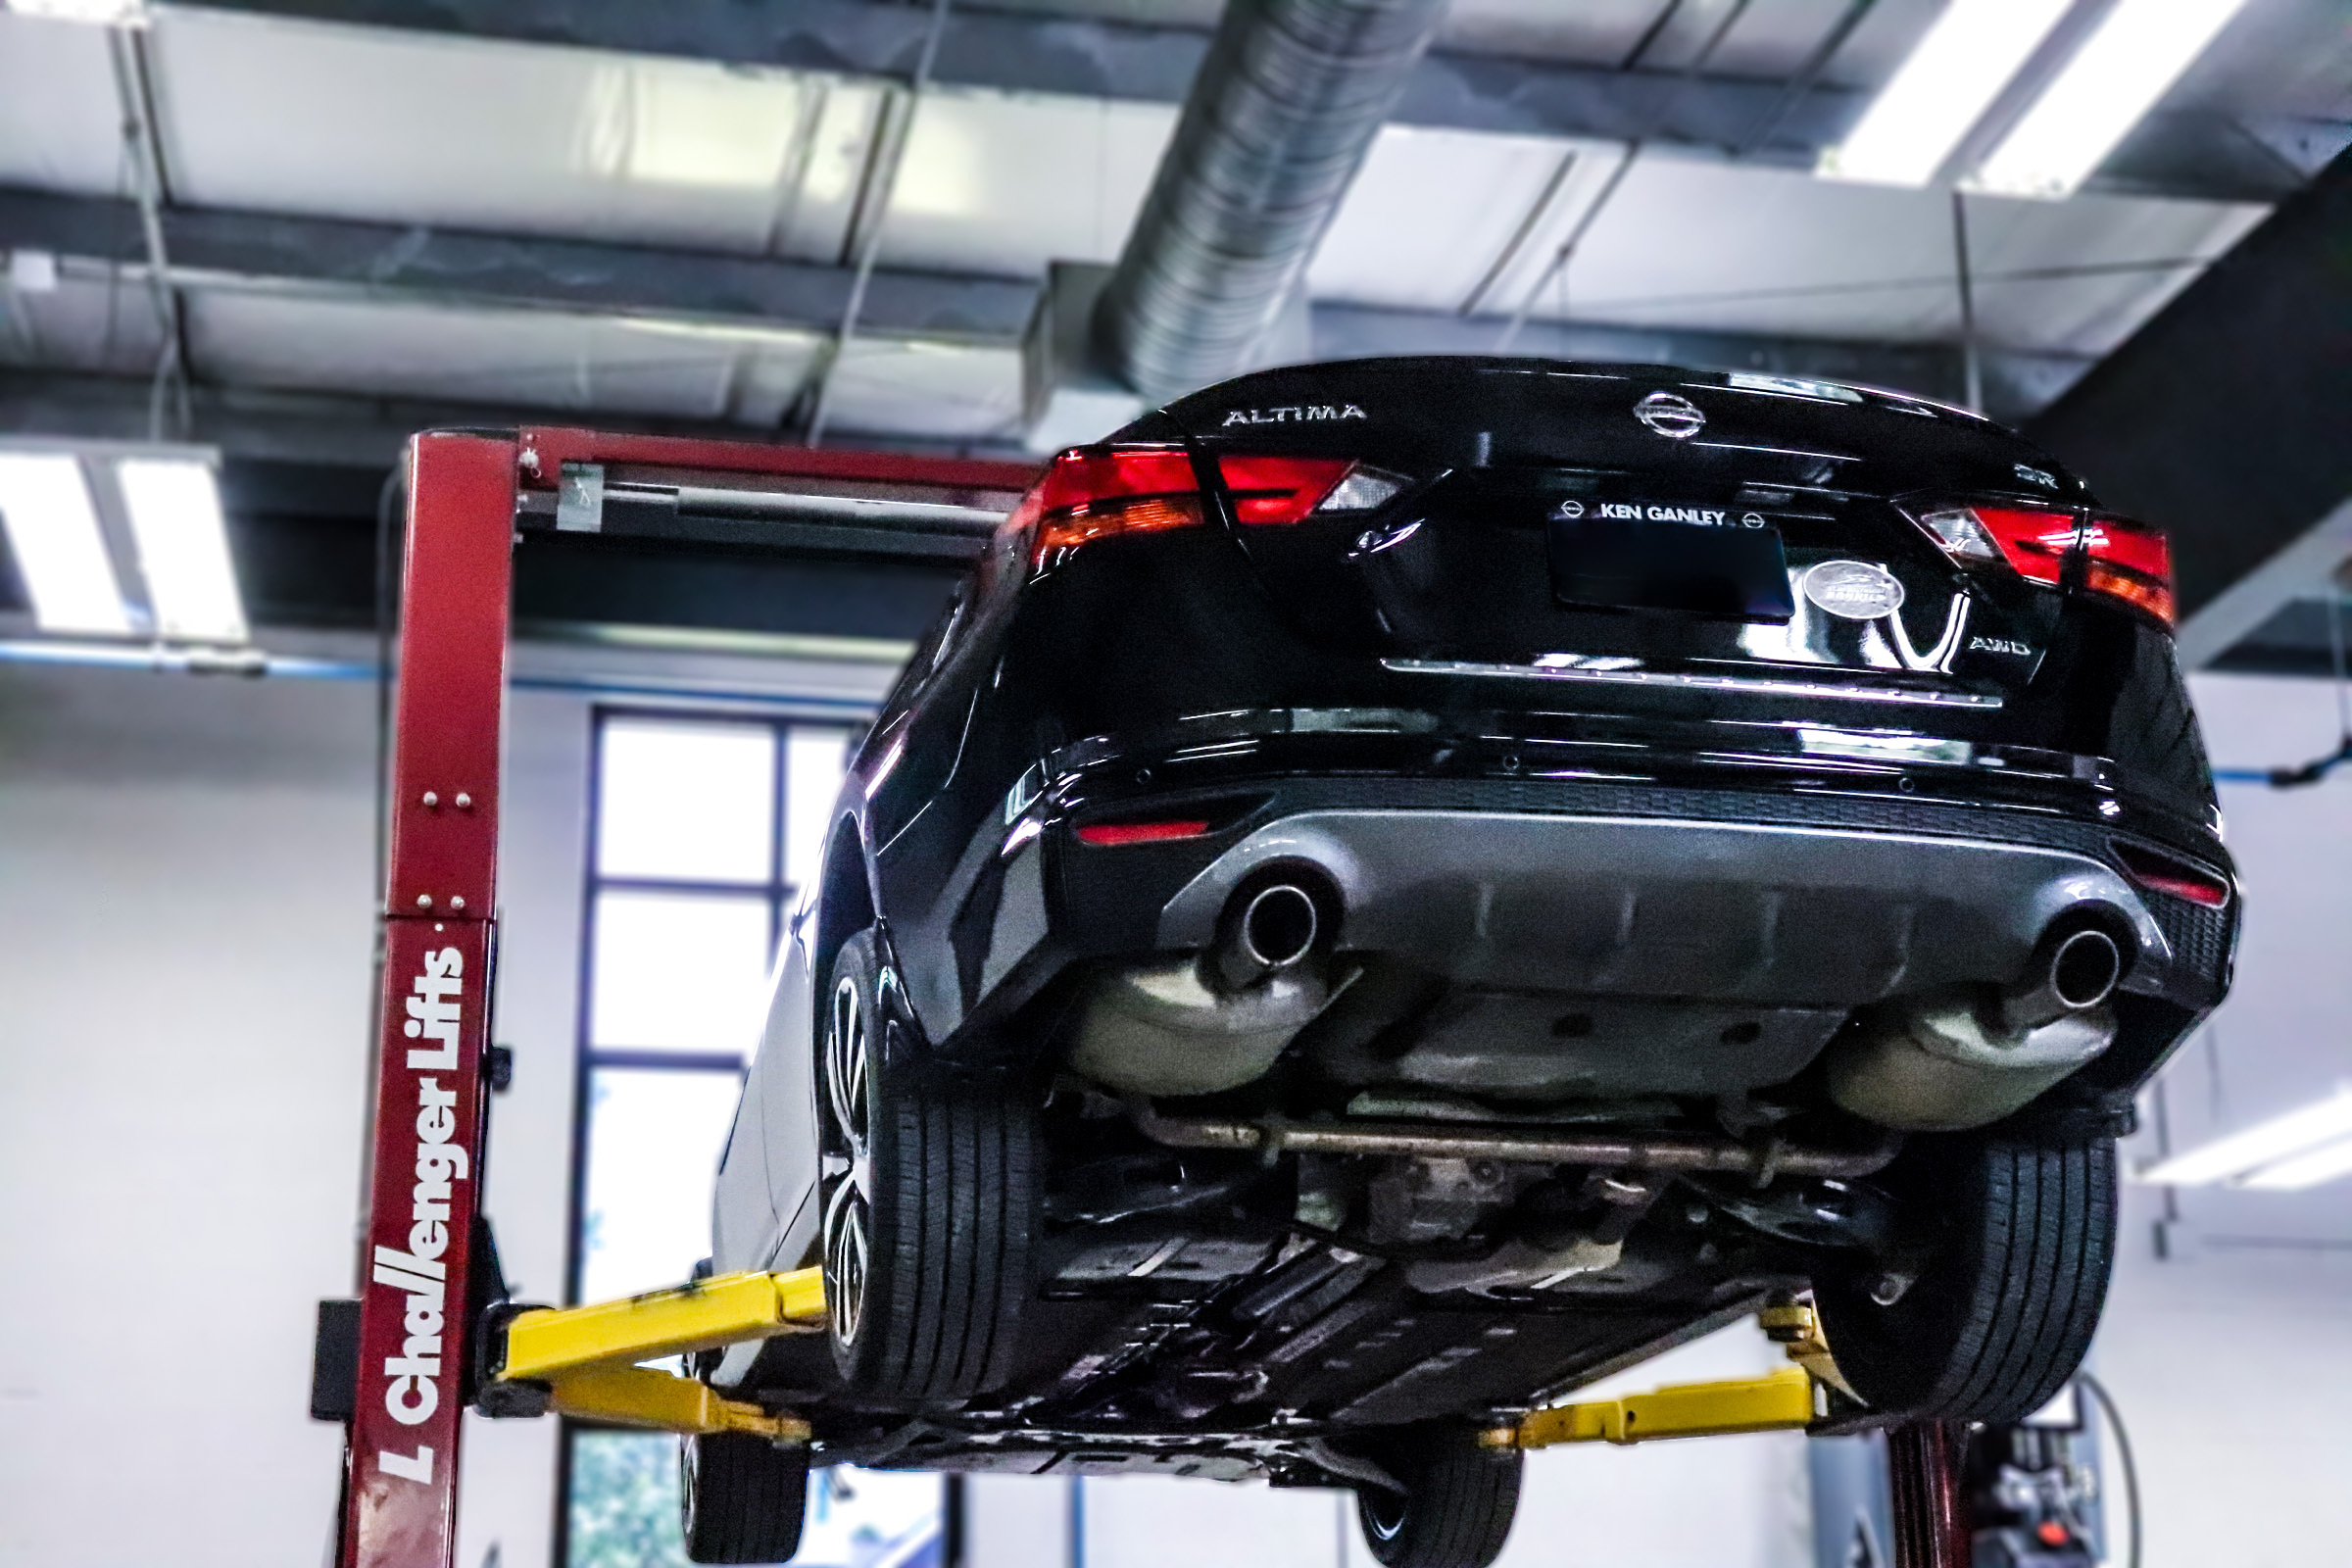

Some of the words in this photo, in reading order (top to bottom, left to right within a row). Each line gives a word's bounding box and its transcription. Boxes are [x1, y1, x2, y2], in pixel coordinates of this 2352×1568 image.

[1221, 404, 1368, 427] ALTIMA
[1600, 503, 1642, 520] KEN
[1646, 506, 1726, 526] GANLEY
[1968, 636, 2032, 656] AWD
[404, 947, 464, 1070] Lifts
[372, 1077, 468, 1425] Challenger
